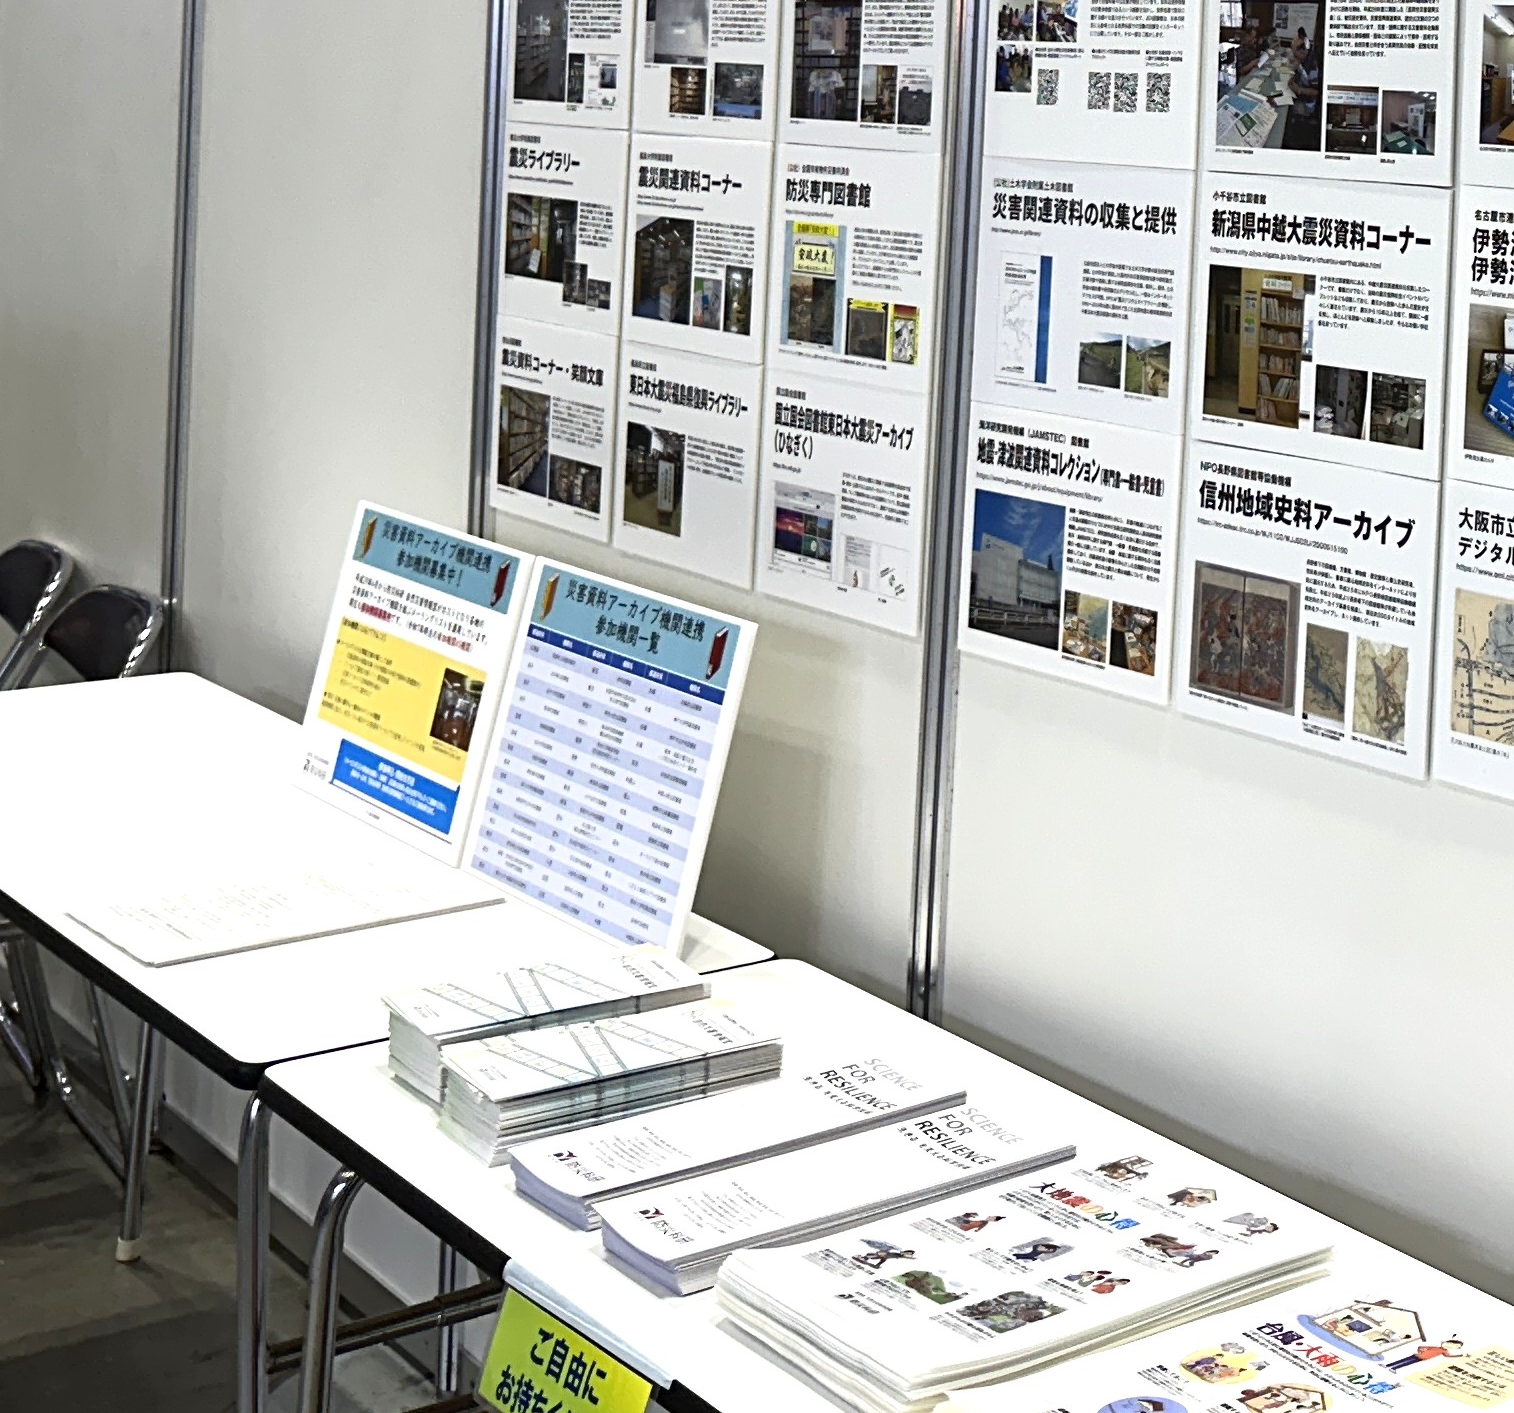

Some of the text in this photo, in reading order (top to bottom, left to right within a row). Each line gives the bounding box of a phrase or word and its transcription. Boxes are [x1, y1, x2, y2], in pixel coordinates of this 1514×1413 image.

[509, 147, 580, 172] 震災ライブラリー
[638, 166, 742, 194] 震災関連資料コーナー
[786, 179, 871, 208] 防災専門図書館
[992, 193, 1177, 235] 災害関連資料の収集と提供
[1212, 209, 1431, 254] 新潟県中越大震災資料コーナー
[775, 429, 813, 459] (ひなぎく)
[1199, 480, 1415, 548] 信州地域史料アーカイブ
[566, 579, 706, 642] 災害資料アーカイブ機関連携
[595, 616, 660, 655] 参加機関一覧
[820, 1070, 897, 1111] RESILIENCE
[842, 1064, 875, 1084] FOR
[864, 1058, 923, 1091] SCIENCE
[915, 1120, 996, 1165] RESILIENCE
[939, 1114, 973, 1137] FOR
[960, 1107, 1023, 1145] SCIENCE
[530, 1328, 607, 1405] ご自由に
[496, 1365, 574, 1413] お持ち
